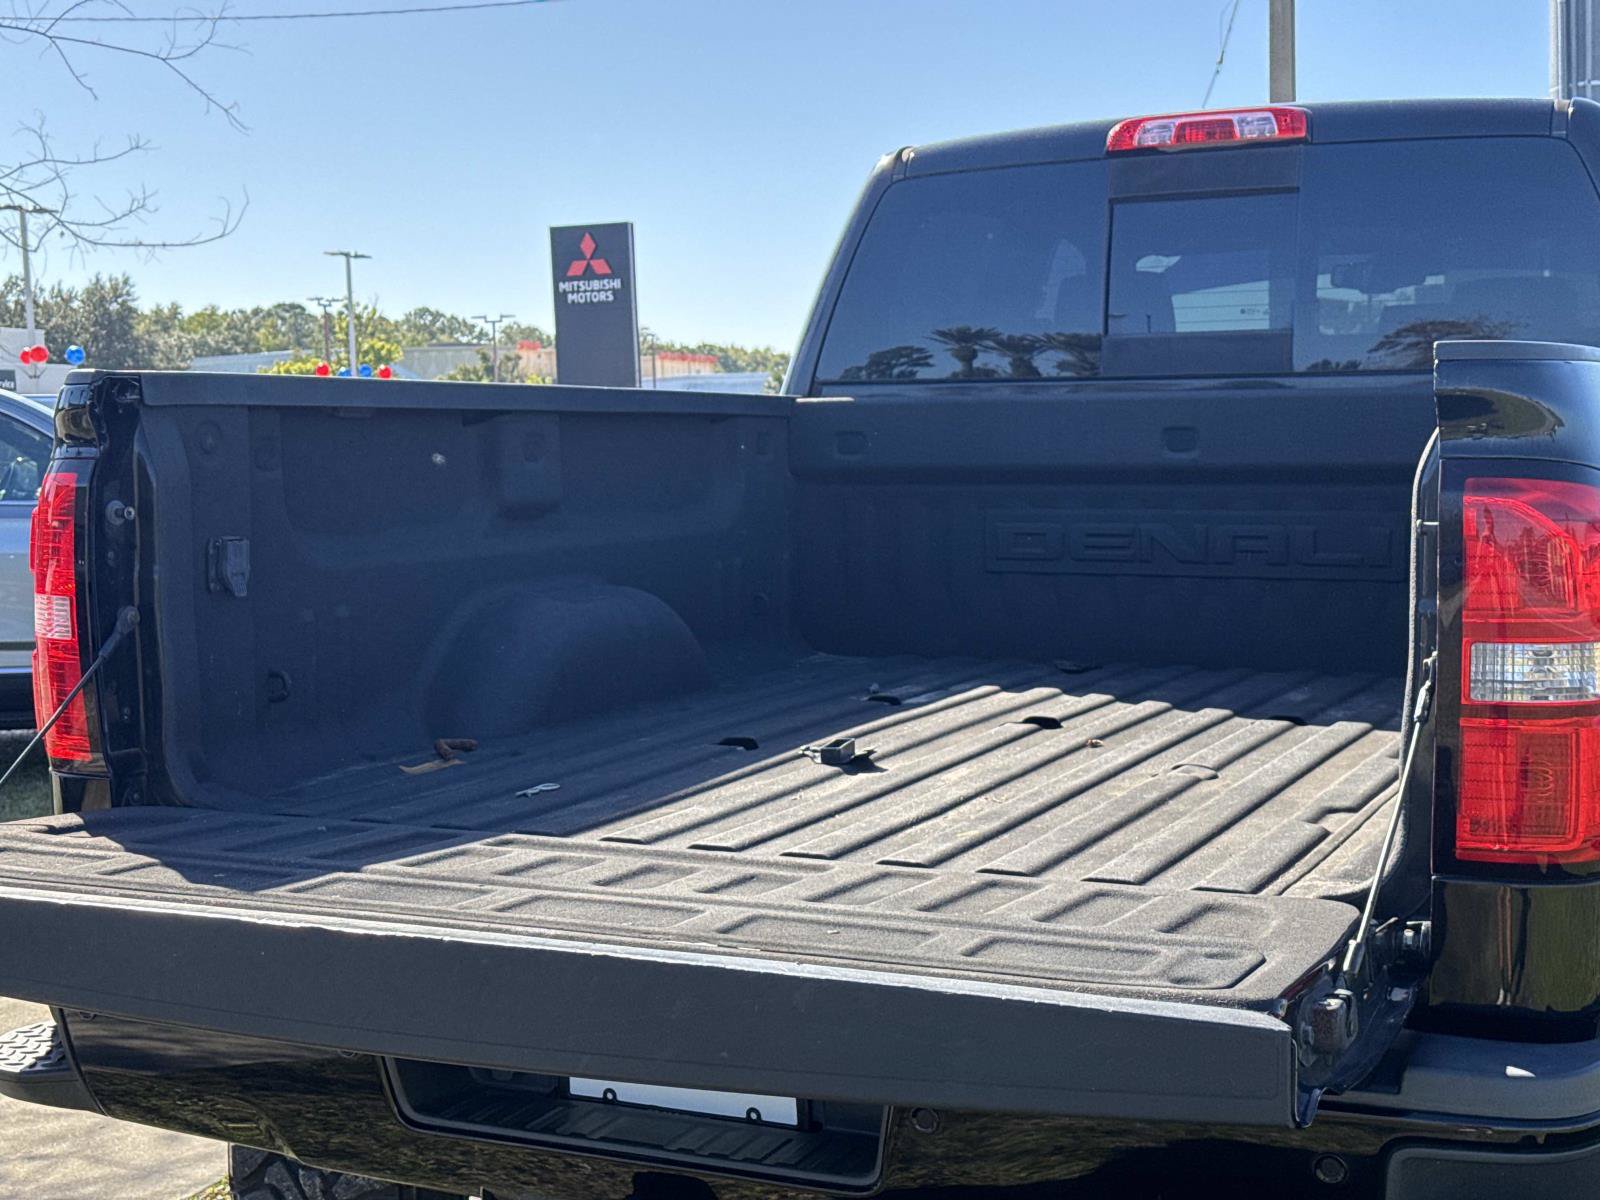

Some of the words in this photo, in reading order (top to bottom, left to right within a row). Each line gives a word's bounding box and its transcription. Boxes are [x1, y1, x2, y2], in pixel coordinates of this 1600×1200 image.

[558, 278, 622, 293] MITSUBISHI
[567, 290, 614, 304] MOTORS
[995, 523, 1393, 568] DENALI
